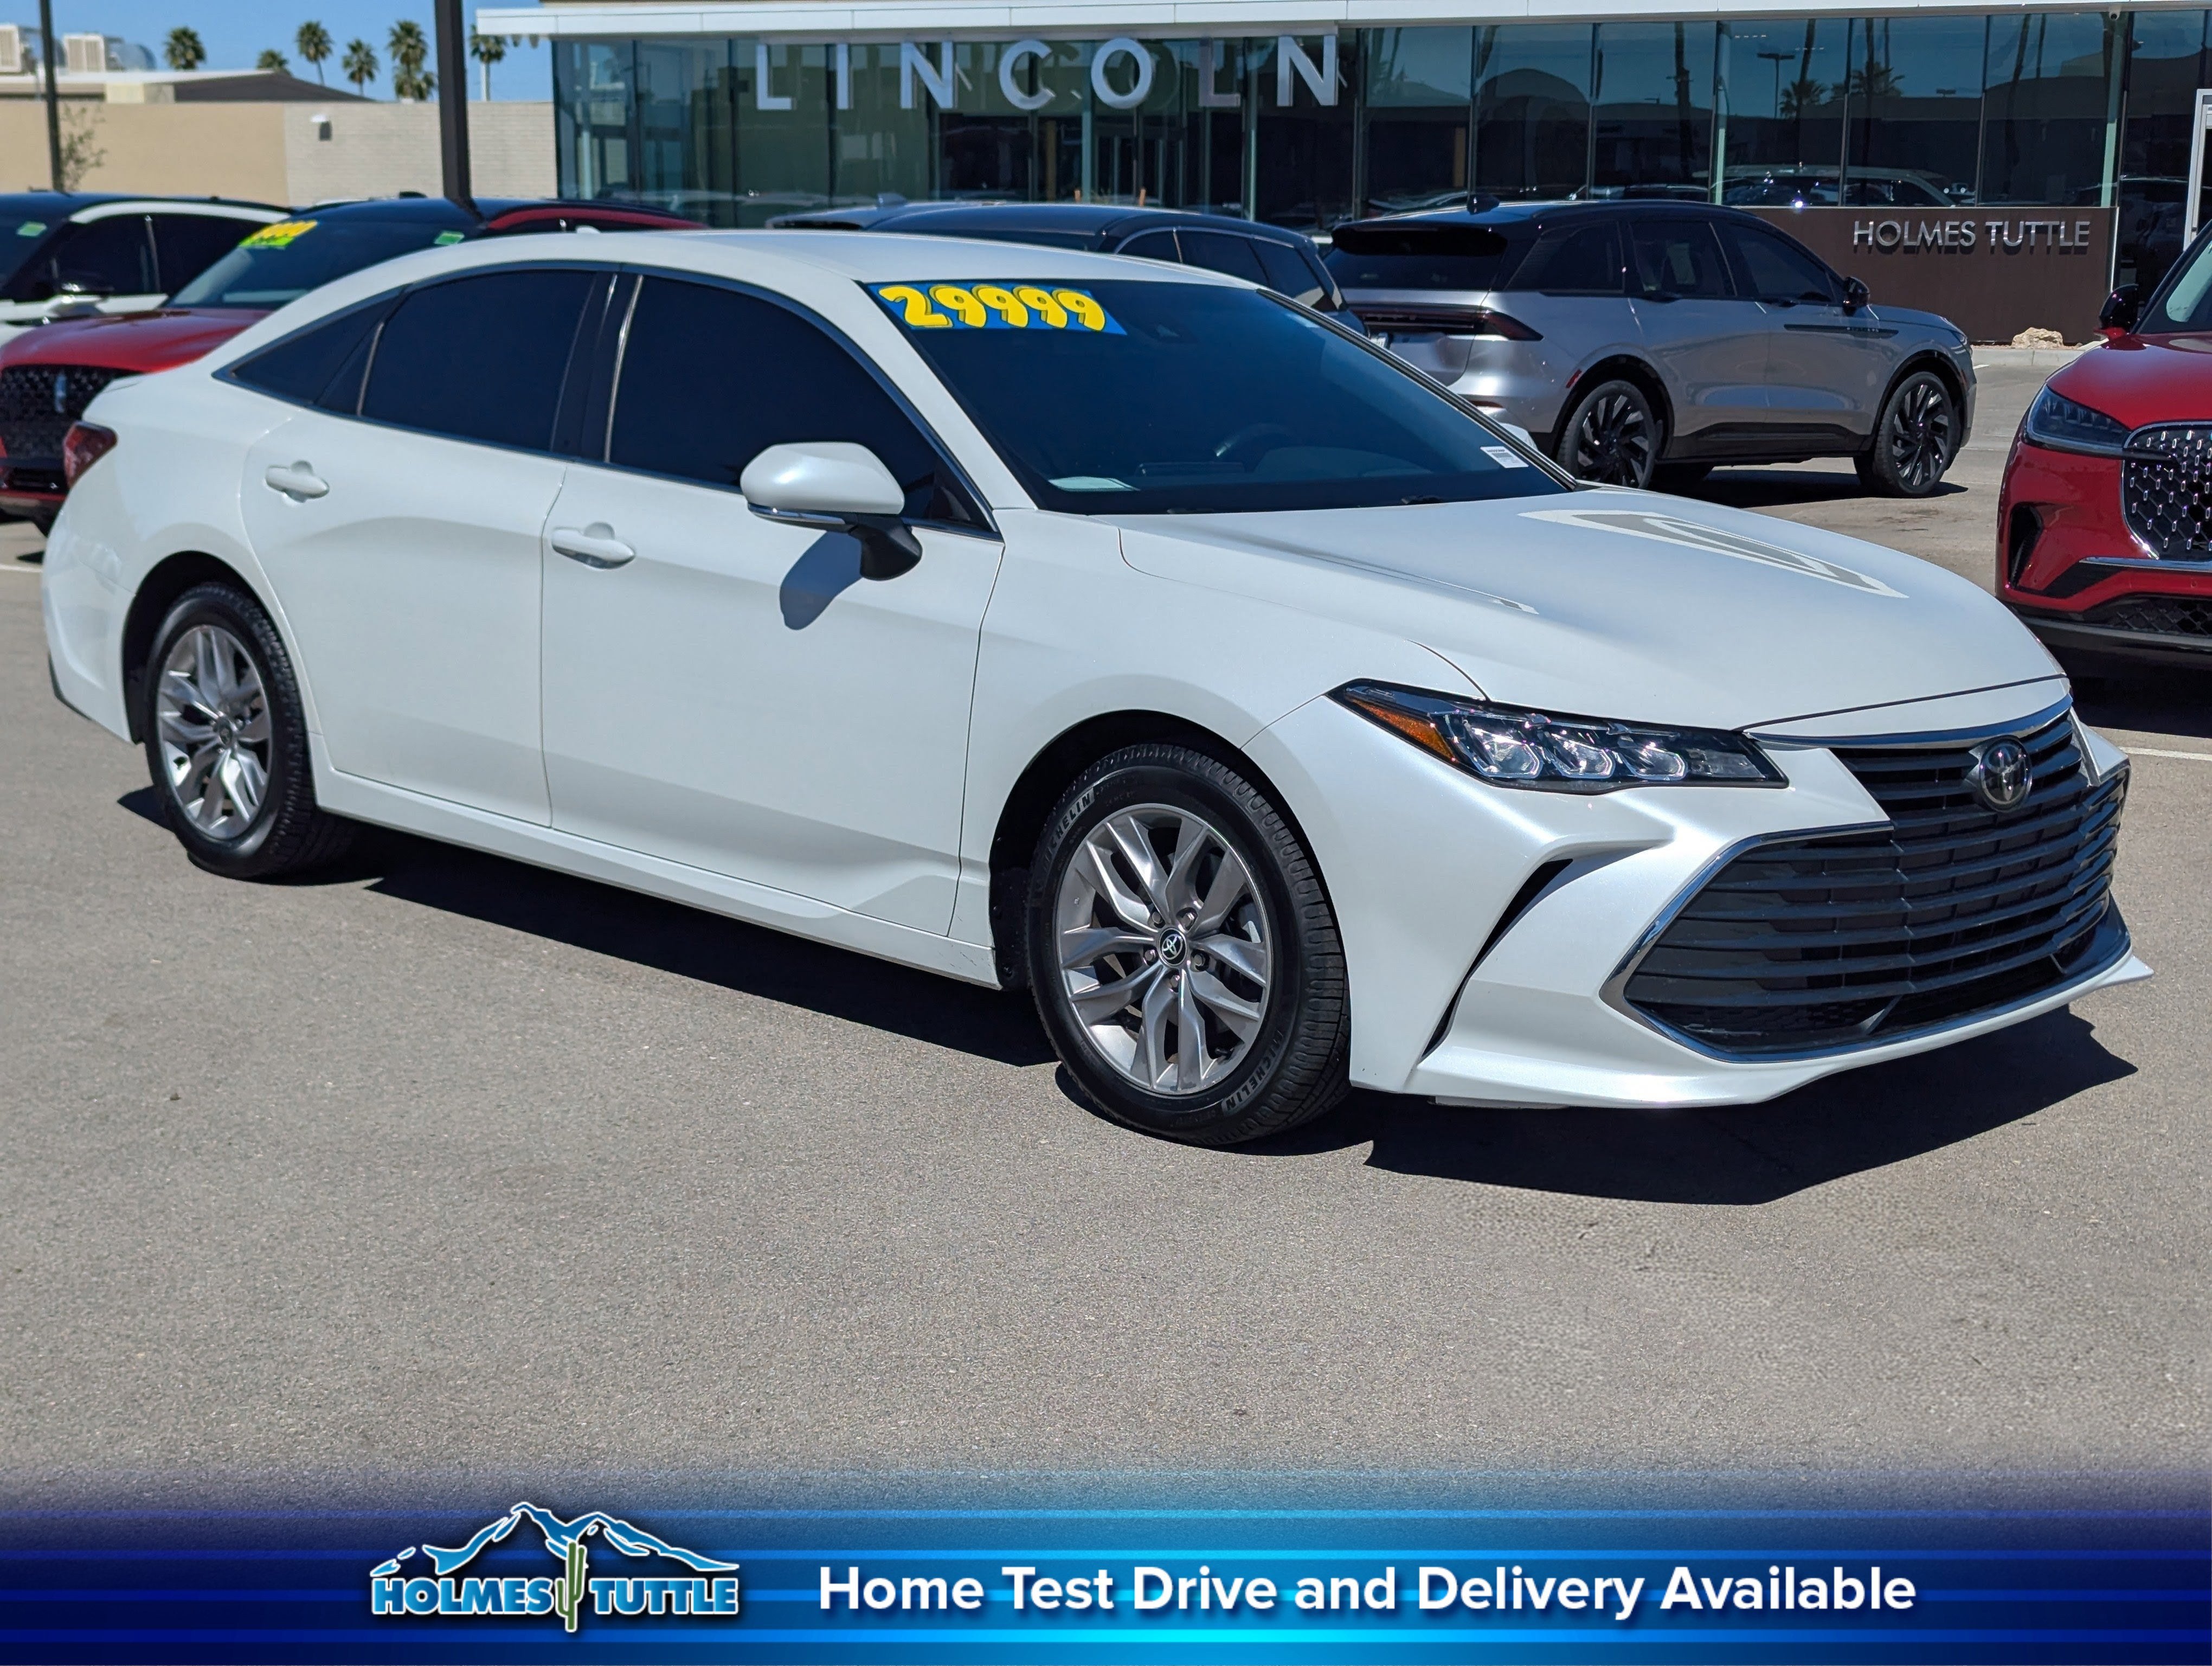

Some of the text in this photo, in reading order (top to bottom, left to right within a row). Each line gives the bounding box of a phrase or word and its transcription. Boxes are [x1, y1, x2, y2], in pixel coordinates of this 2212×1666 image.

[757, 37, 1338, 110] LINCOLN
[1853, 220, 2091, 247] HOLMES TUTTLE
[878, 284, 1106, 332] 29999
[1225, 1028, 1284, 1111] MICHELIN
